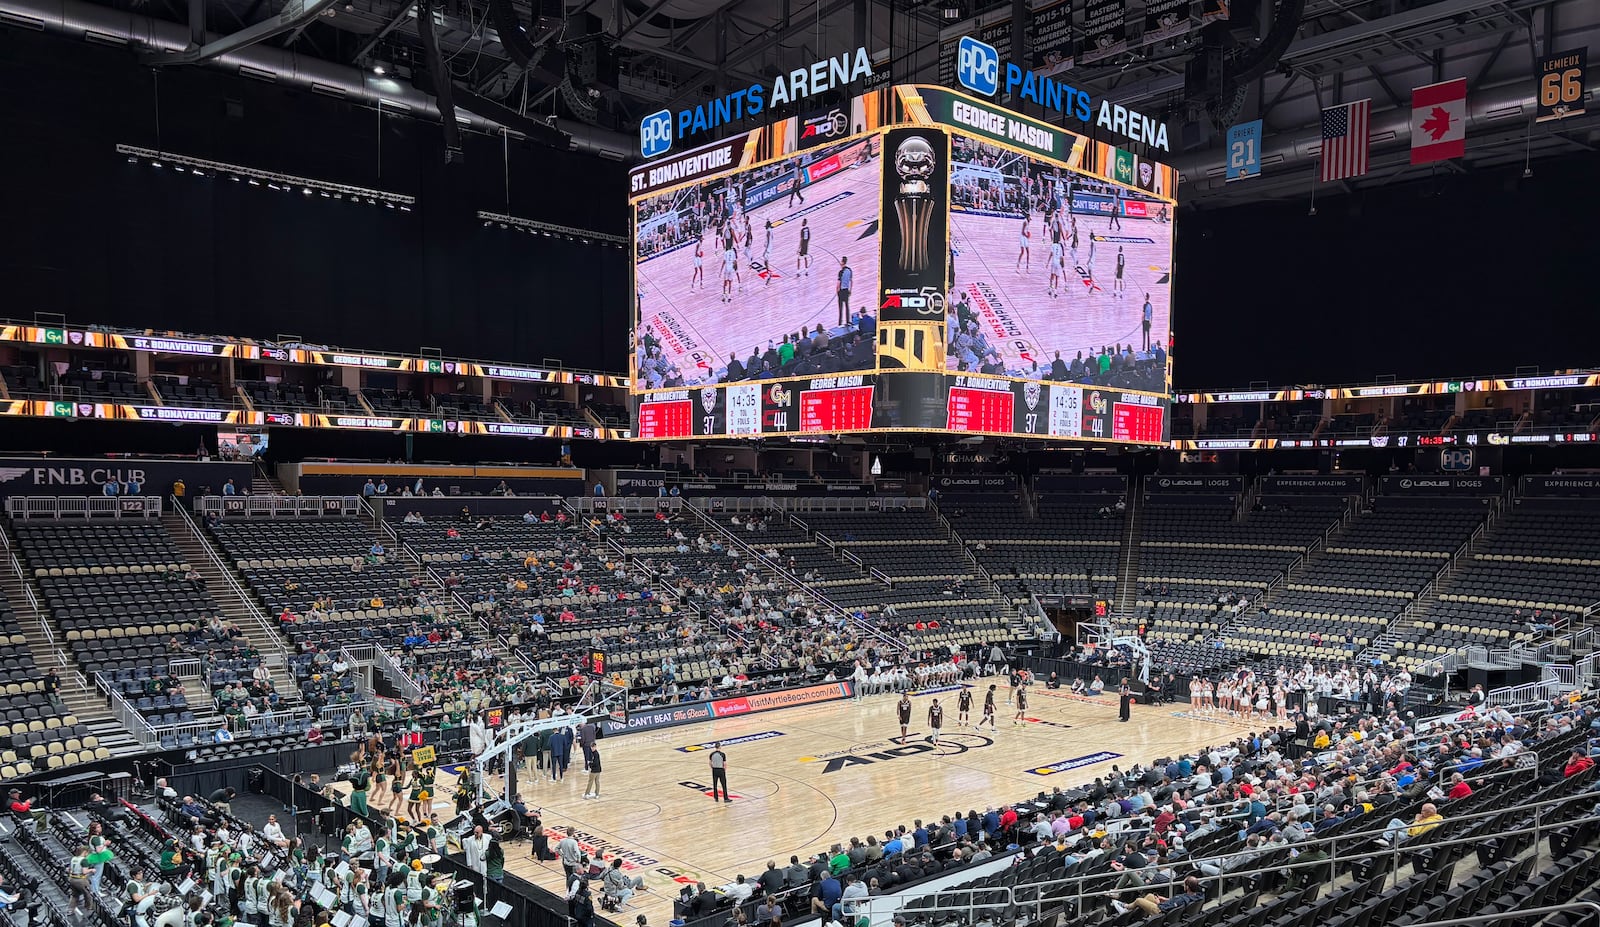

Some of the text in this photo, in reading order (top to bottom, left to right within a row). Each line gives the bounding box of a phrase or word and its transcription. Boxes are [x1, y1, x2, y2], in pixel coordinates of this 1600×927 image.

[1035, 4, 1071, 25] 2015-16
[1090, 2, 1120, 18] EASTERN
[1038, 20, 1066, 35] EASTERN
[1085, 17, 1124, 36] CHAMPIONS
[1033, 26, 1072, 45] CONFERENCE
[1033, 35, 1071, 53] CHAMPIONS
[1543, 54, 1580, 71] LEMIEUX
[1541, 68, 1582, 107] 66
[643, 47, 872, 152] PPG PAINTS ARENA
[960, 45, 1169, 152] PPG PAINTS ARENA
[953, 100, 1053, 152] GEORGE MASON
[1232, 139, 1255, 168] 21
[631, 145, 732, 192] ST. BONAVENTURE
[763, 186, 776, 200] BEAT
[881, 286, 944, 314] A10 50
[135, 339, 213, 353] ST. BONAVENTURE
[333, 355, 387, 367] GEORGE MASON
[488, 368, 541, 379] ST. BONAVENTURE
[810, 375, 864, 390] GEORGE MASON
[955, 376, 1011, 391] ST. BONAVENTURE
[1513, 377, 1579, 388] ST. BONAVENTURE
[732, 394, 756, 408] 14:35
[1056, 396, 1077, 409] 14:35
[1229, 393, 1270, 401] BONAVENTURE
[141, 408, 222, 421] ST. BONAVENTURE
[737, 417, 750, 425] FOULS
[774, 411, 787, 432] 44
[337, 418, 393, 428] GEORGE MASON
[489, 424, 543, 434] ST. BONAVENTURE
[703, 416, 715, 435] 37
[1025, 413, 1037, 433] 37
[1092, 418, 1103, 437] 44
[1398, 436, 1408, 446] 37
[1420, 437, 1443, 445] 14:35
[1467, 435, 1478, 444] 44
[1180, 451, 1217, 463] FedEx
[1444, 450, 1470, 468] PPG
[33, 468, 146, 485] F.N.B. CLUB
[122, 501, 142, 511] 122
[227, 501, 243, 510] 101
[325, 501, 340, 510] 101
[594, 501, 606, 509] 103
[749, 687, 840, 708] VisitMyrtleBeach.com/A10
[488, 716, 502, 726] 30
[628, 716, 652, 727] CAN'T
[655, 713, 671, 723] BEAT
[673, 711, 687, 720] The
[688, 708, 708, 719] Beach
[818, 744, 934, 774] A10
